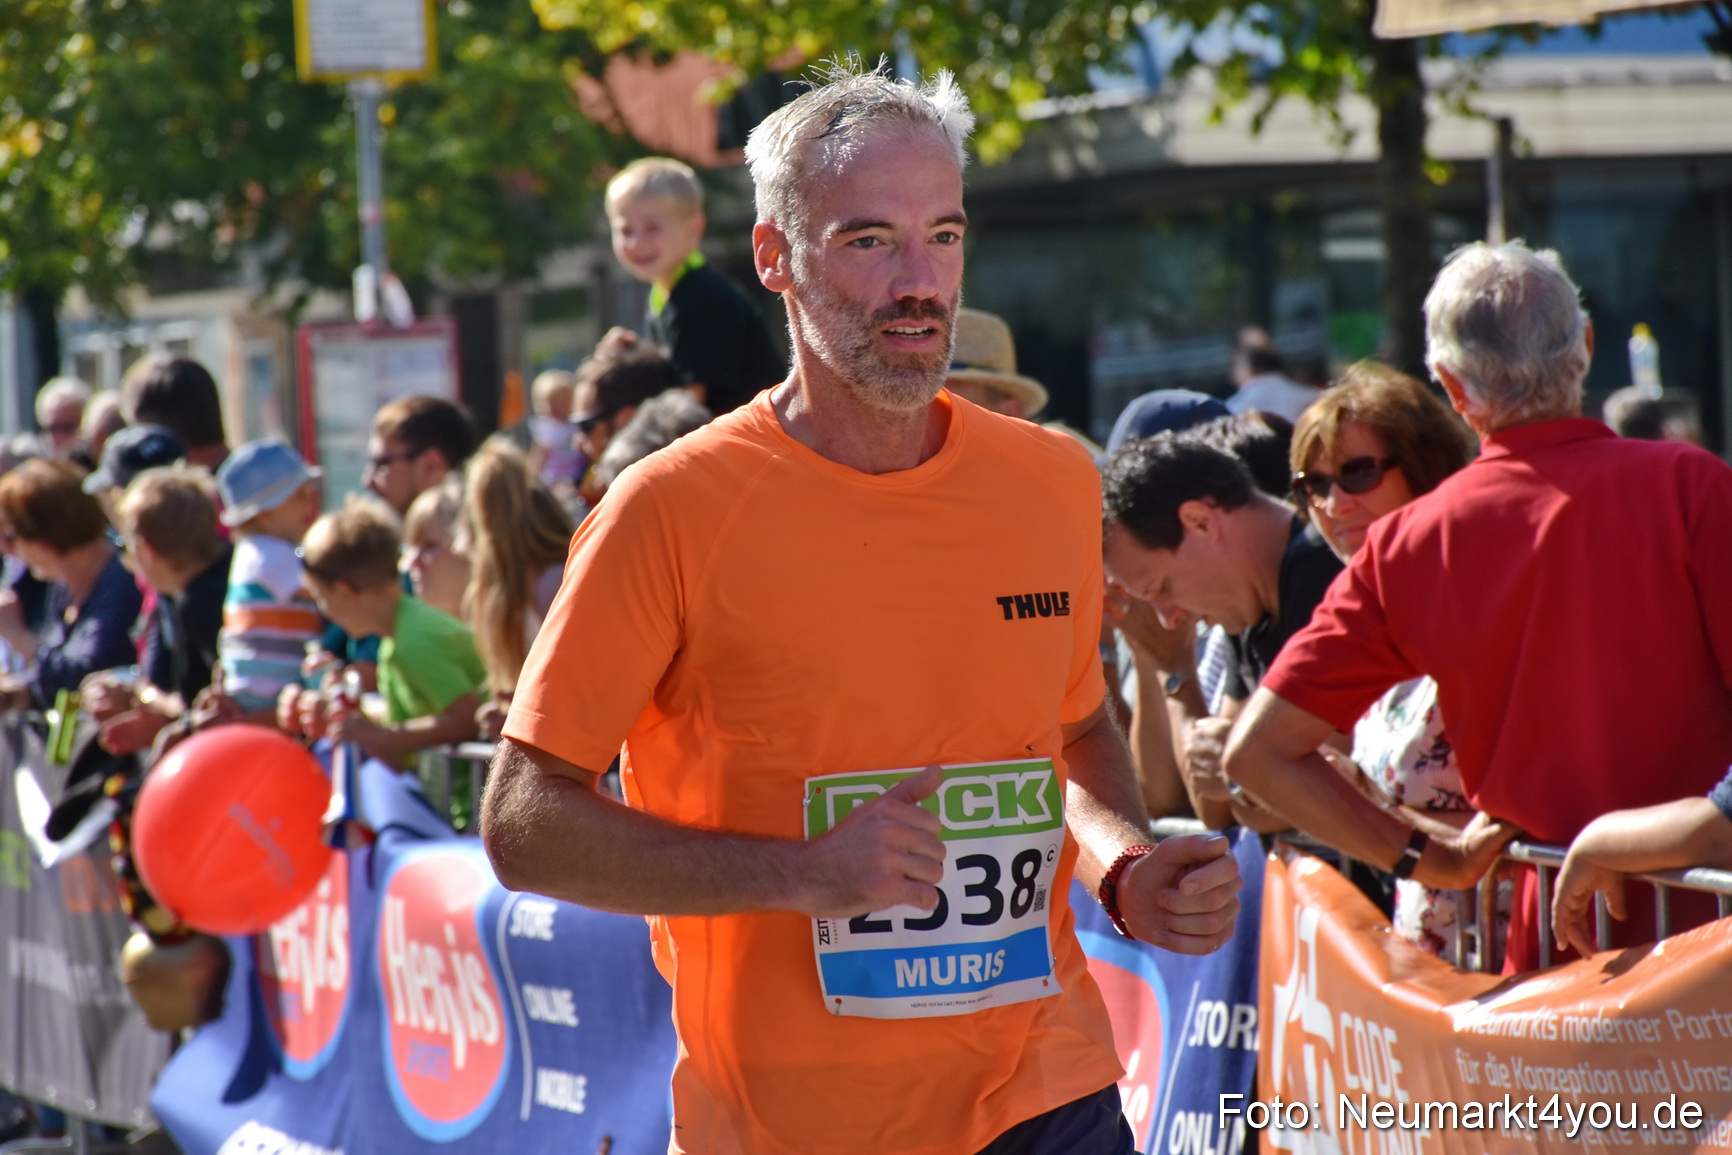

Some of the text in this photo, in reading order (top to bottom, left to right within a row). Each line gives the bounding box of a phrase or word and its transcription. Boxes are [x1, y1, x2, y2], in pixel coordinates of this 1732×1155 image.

[996, 592, 1069, 621] THULE
[826, 769, 1053, 831] CK
[894, 949, 1006, 989] MURIS
[1188, 1000, 1260, 1052] STOR
[1340, 1012, 1410, 1104] CODE
[1455, 1048, 1732, 1105] für die Konzeption und Ums
